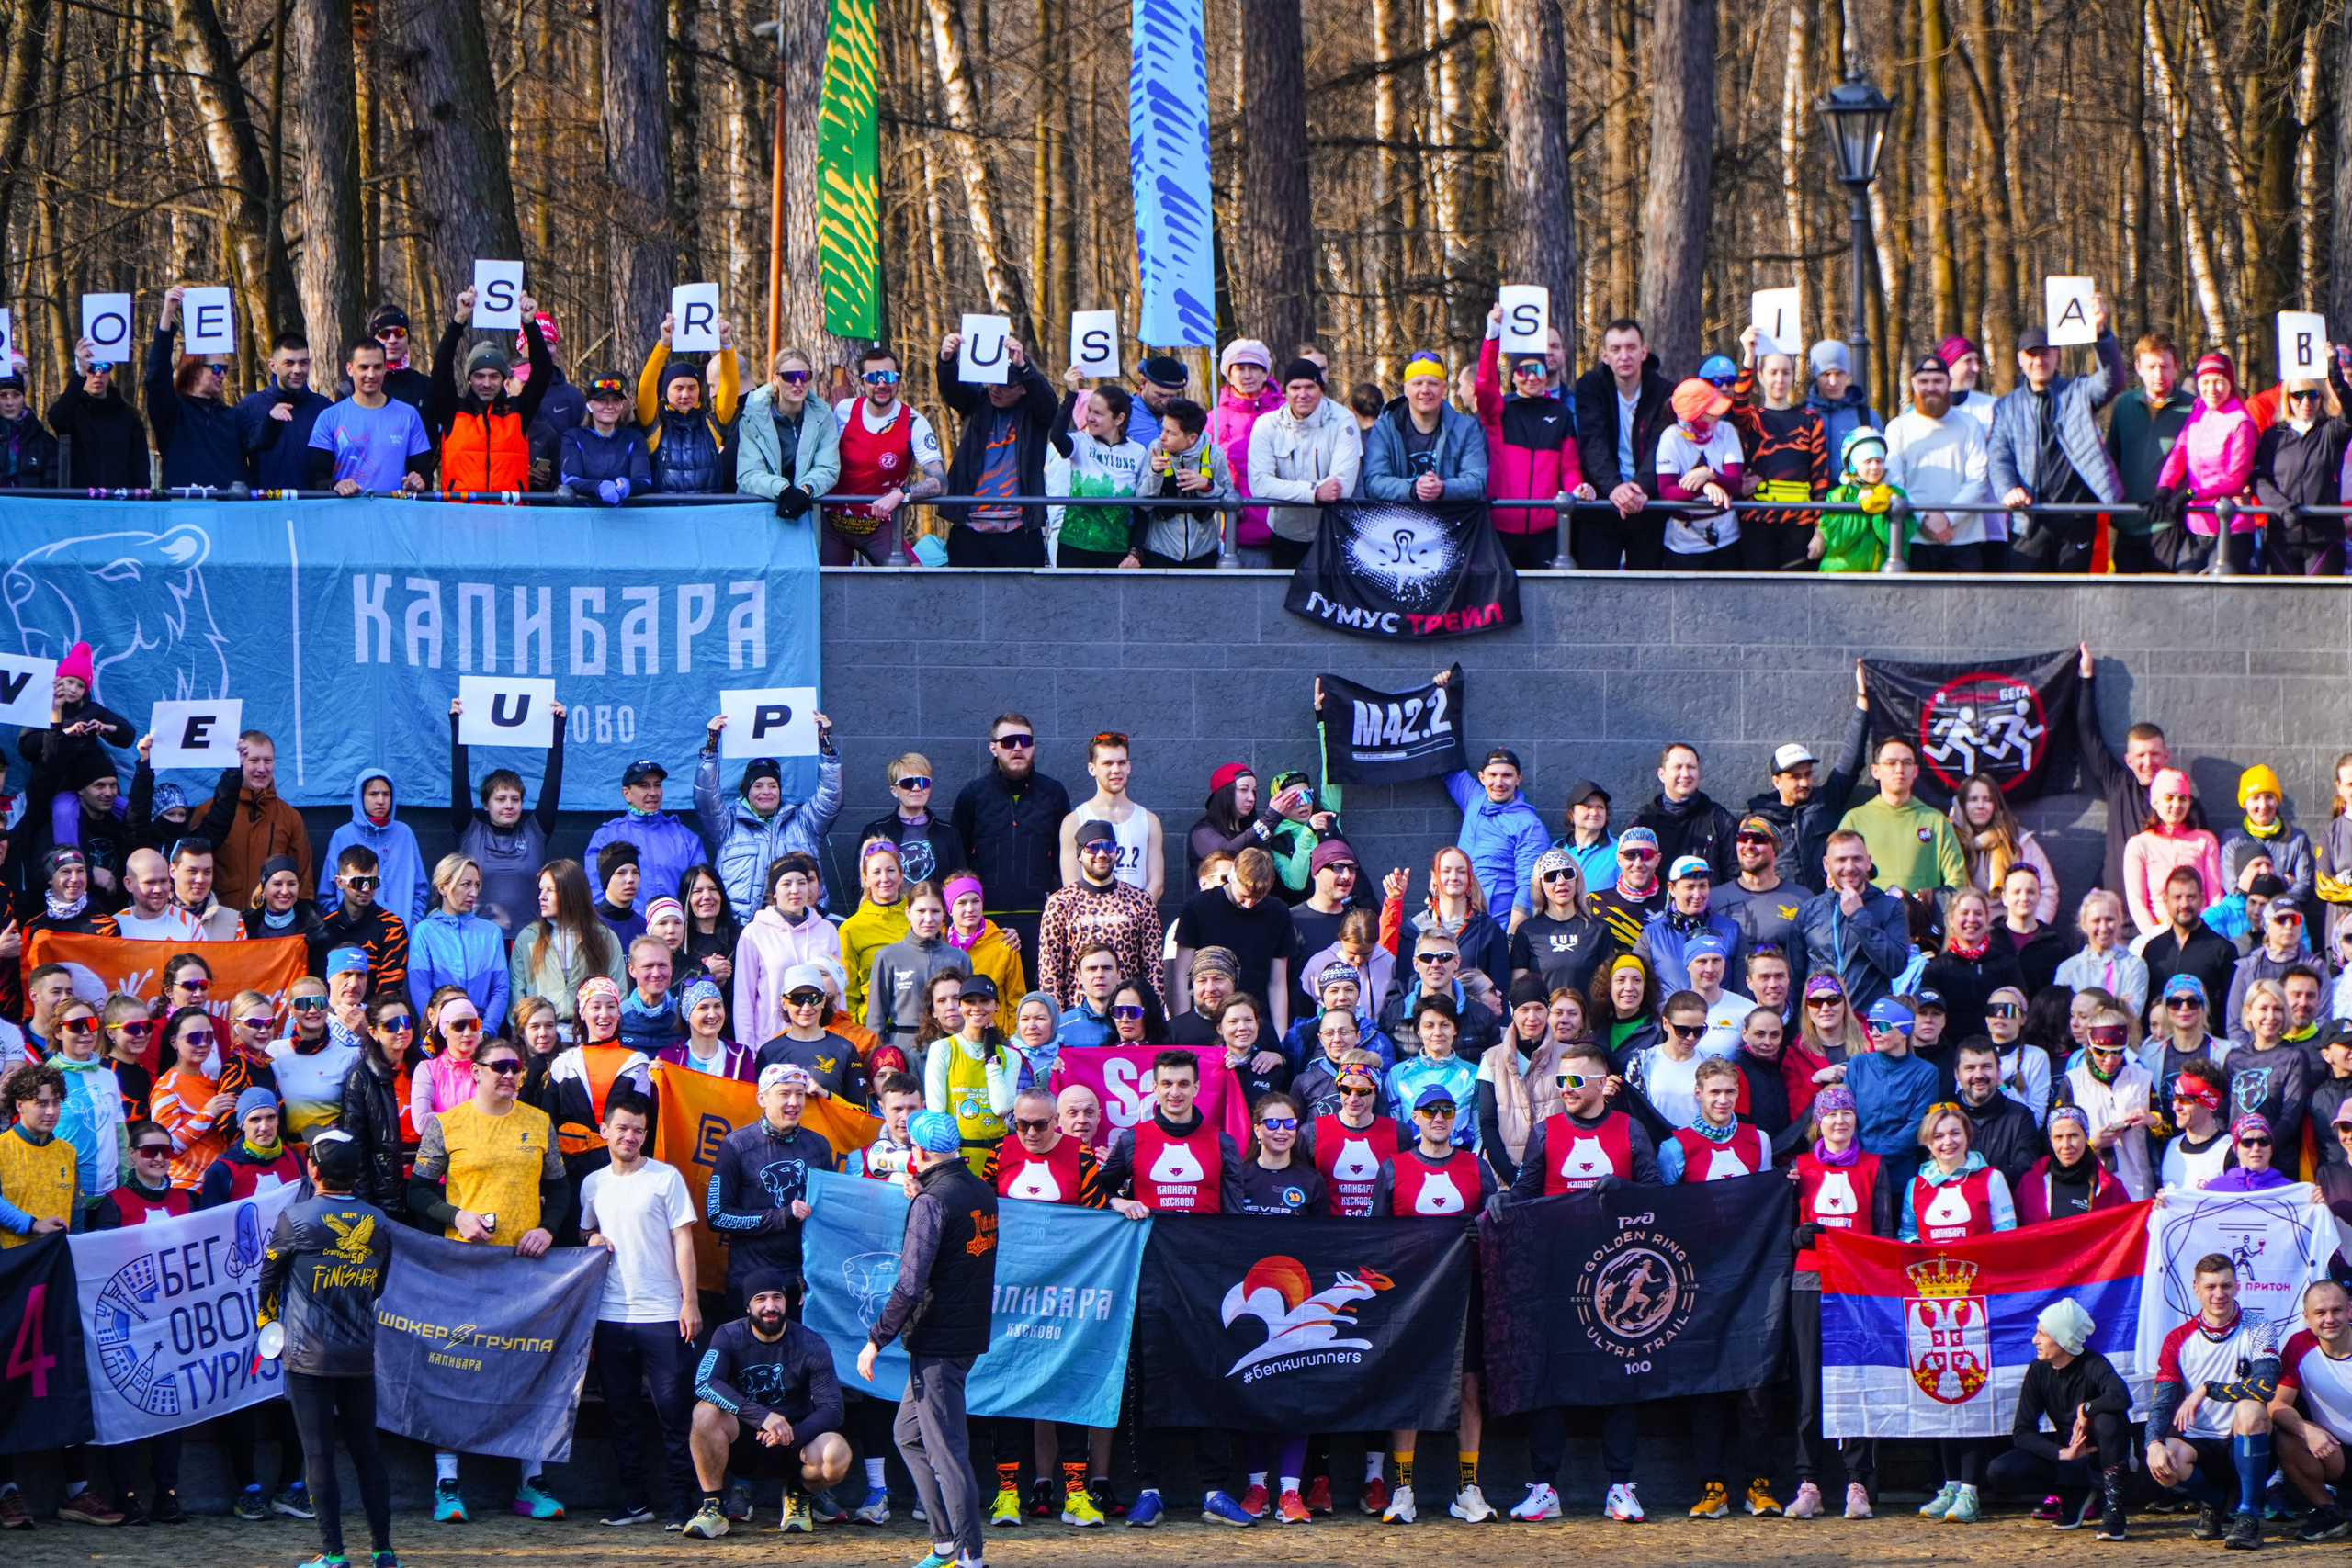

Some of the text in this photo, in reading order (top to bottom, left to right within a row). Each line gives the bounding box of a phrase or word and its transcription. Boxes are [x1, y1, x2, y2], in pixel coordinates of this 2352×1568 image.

[484, 279, 515, 312] S
[2056, 296, 2087, 327] A
[90, 312, 127, 345] O
[197, 305, 224, 338] E
[684, 301, 714, 335] R
[1510, 304, 1541, 336] S
[1775, 307, 1782, 338] I
[970, 333, 1003, 367] U
[1080, 330, 1111, 363] S
[2296, 332, 2312, 366] B
[353, 574, 768, 676] КАПИБАРА
[1306, 591, 1503, 635] ГУМУС ТРЕЙЛ
[490, 694, 531, 728] U
[752, 705, 793, 739] P
[1351, 687, 1453, 747] M42.2
[182, 716, 217, 750] E
[1549, 934, 1578, 944] RUN
[1253, 1080, 1271, 1089] FILA
[1156, 1185, 1198, 1195] КАПИБАРА
[1159, 1197, 1195, 1207] КУСКОВО
[158, 1235, 220, 1299] БЕГ
[350, 1252, 365, 1265] 50
[1584, 1230, 1688, 1273] GOLDEN RING
[2245, 1282, 2291, 1292] ПРИТОН
[6, 1284, 57, 1398] 4
[378, 1311, 554, 1353] ШОКЕР ГРУППА
[1006, 1322, 1062, 1340] КУСКОВО
[1586, 1315, 1690, 1359] ULTRA TRAIL
[428, 1352, 482, 1372] КАПИБАРА
[1624, 1359, 1652, 1375] 100
